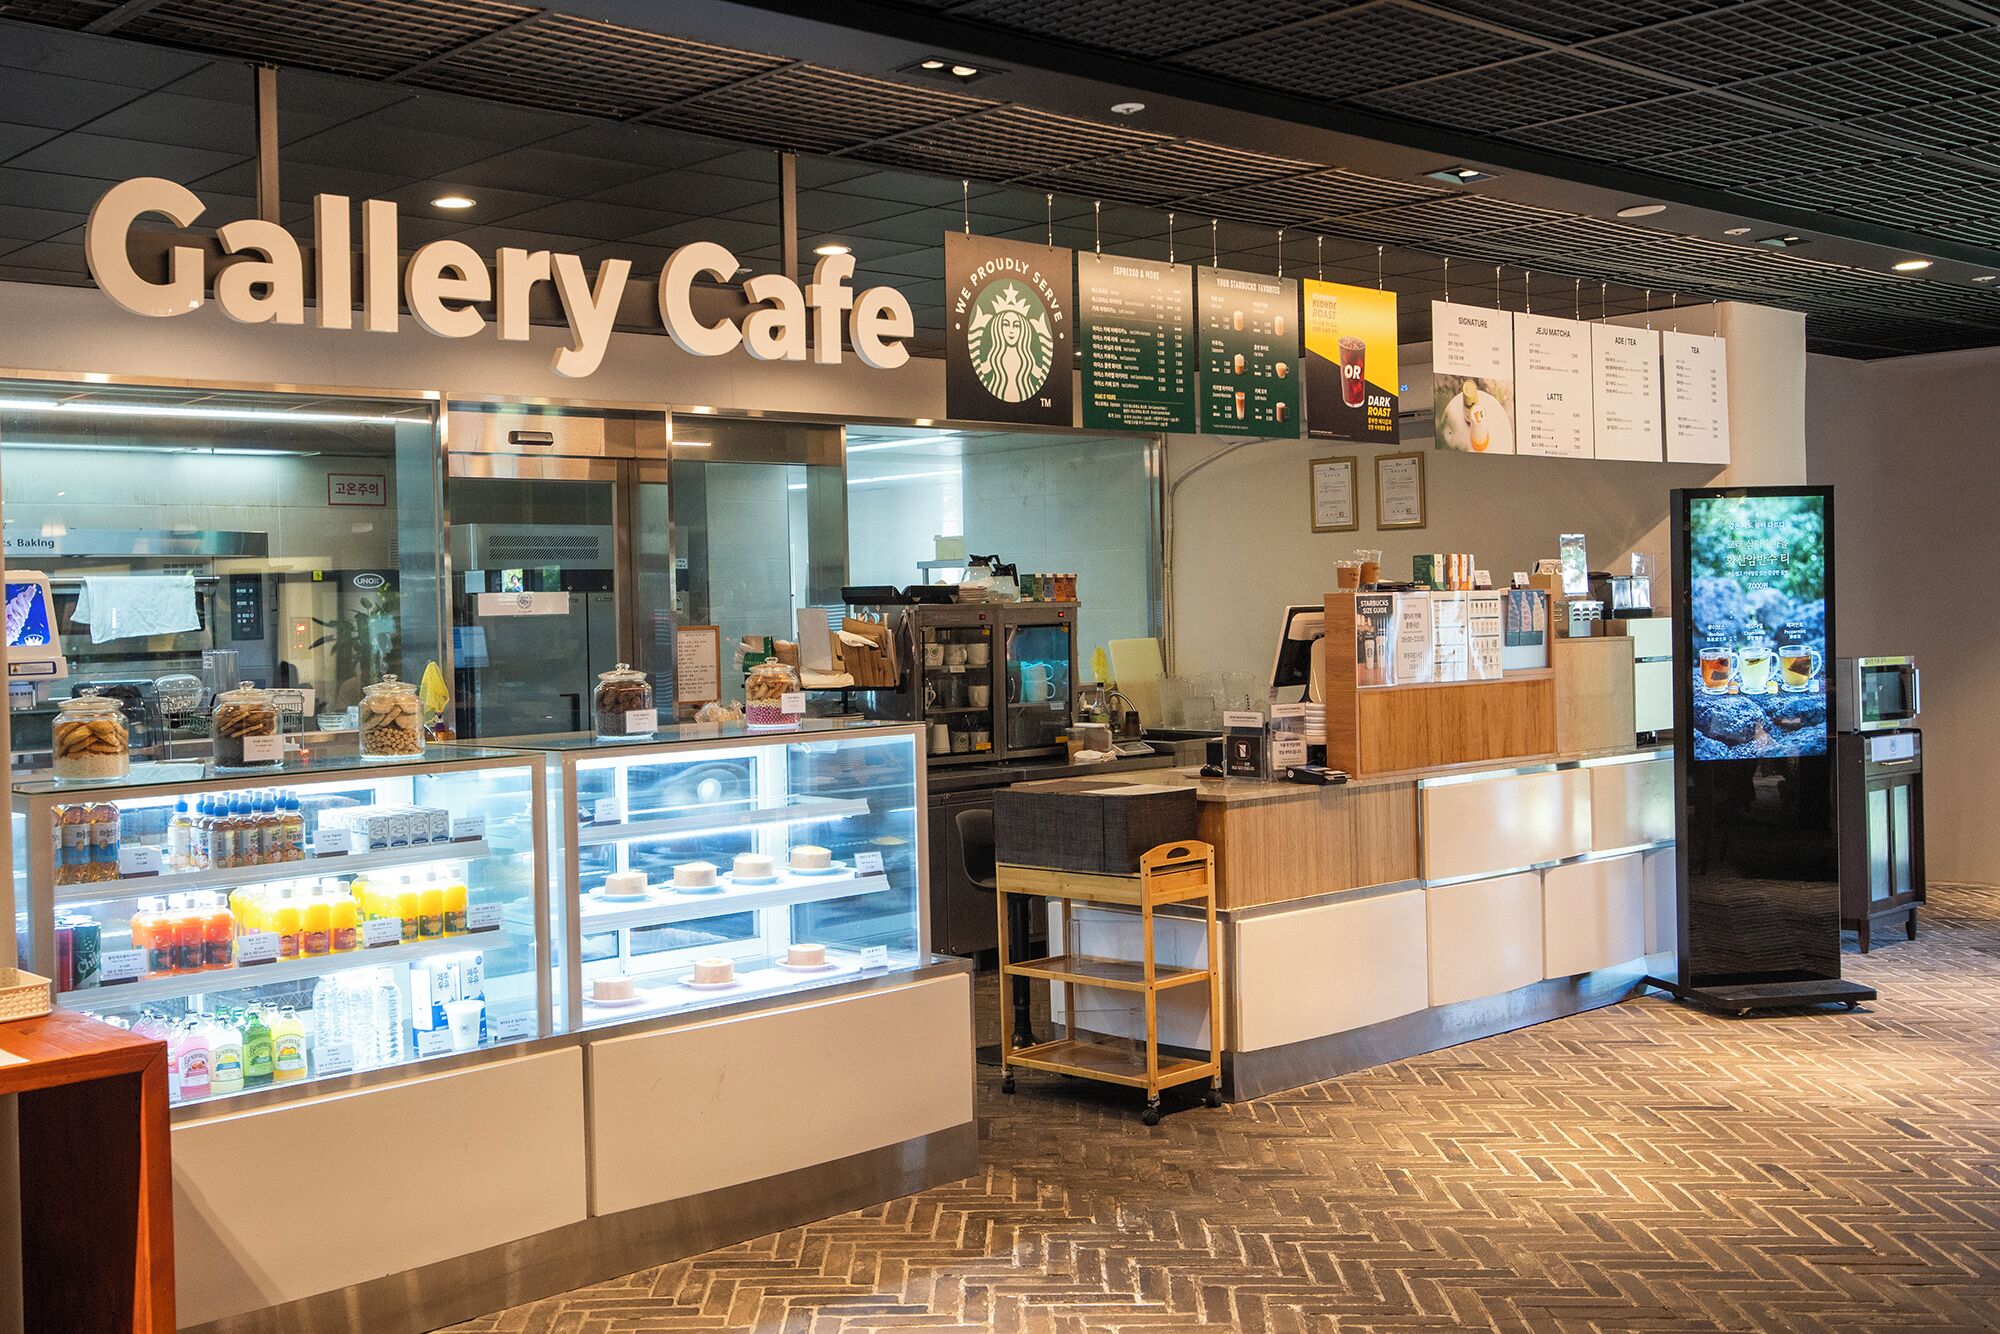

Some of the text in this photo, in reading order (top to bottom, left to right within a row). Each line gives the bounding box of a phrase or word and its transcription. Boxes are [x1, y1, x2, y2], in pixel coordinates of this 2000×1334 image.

[85, 176, 915, 378] Gallery Cafe
[1113, 265, 1160, 281] ESPRESSO & MORE
[955, 257, 1063, 323] WE PROUDLY SERVE
[1216, 278, 1280, 295] YOUR STARBUCKS FAVORITES
[1312, 299, 1337, 310] BLONDE
[1312, 308, 1337, 320] ROAST
[1458, 316, 1488, 329] SIGNATURE
[1535, 327, 1571, 338] JEJU MATCHA
[1614, 337, 1624, 345] ADE
[1627, 338, 1637, 346] TEA
[1691, 346, 1700, 354] TEA
[1344, 364, 1362, 380] OR
[1040, 397, 1052, 408] TM
[1367, 395, 1392, 408] DARK
[1546, 392, 1563, 402] LATTE
[1367, 407, 1392, 418] ROAST
[17, 538, 55, 549] Baking
[1726, 552, 1790, 567] 화산암반수 티
[1360, 600, 1390, 608] STARBUCKS
[1362, 606, 1388, 615] SIZE GUIDE
